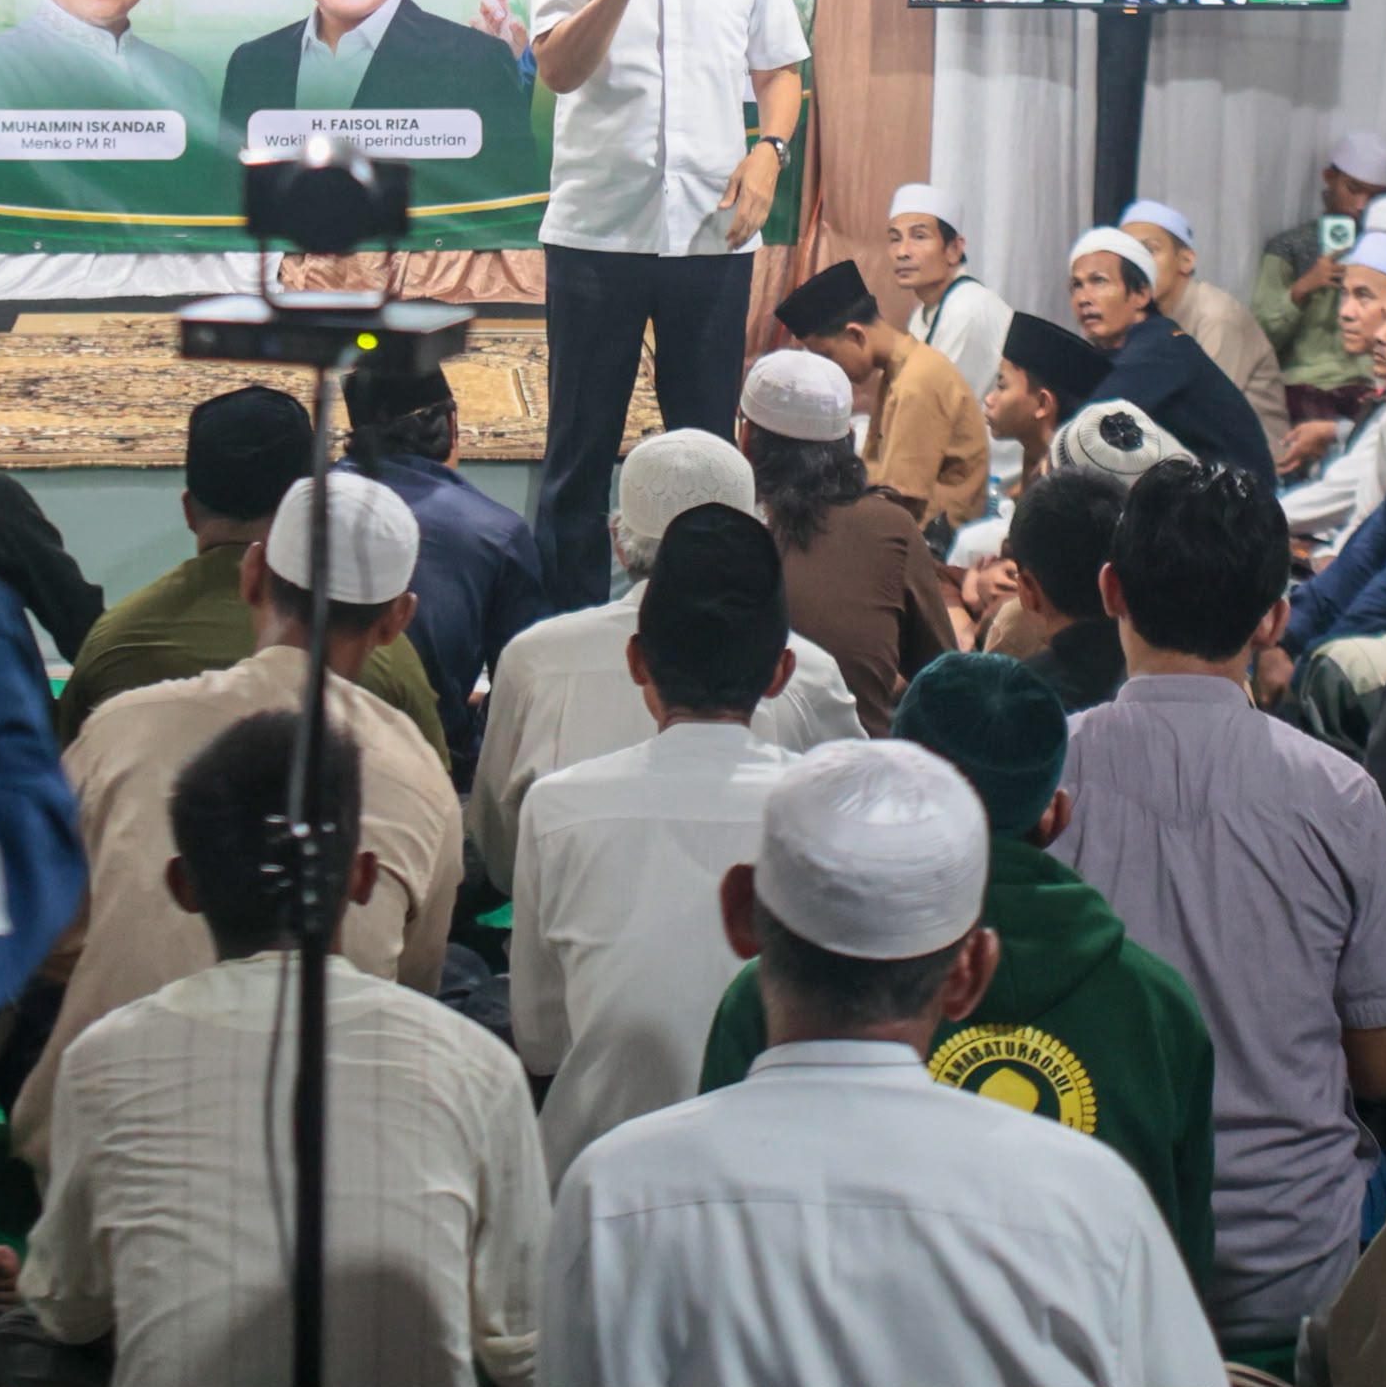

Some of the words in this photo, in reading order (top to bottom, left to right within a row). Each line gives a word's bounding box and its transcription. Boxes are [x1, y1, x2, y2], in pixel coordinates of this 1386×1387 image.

[1, 120, 84, 133] MUHAIMIN
[86, 120, 167, 133] ISKANDAR
[311, 118, 327, 131] H.
[330, 118, 383, 131] FAISOL
[385, 118, 421, 131] RIZA
[21, 137, 73, 150] Menko
[76, 138, 99, 150] PM
[103, 138, 117, 150] RI
[264, 134, 306, 147] Wakil
[364, 132, 467, 151] perindustrian
